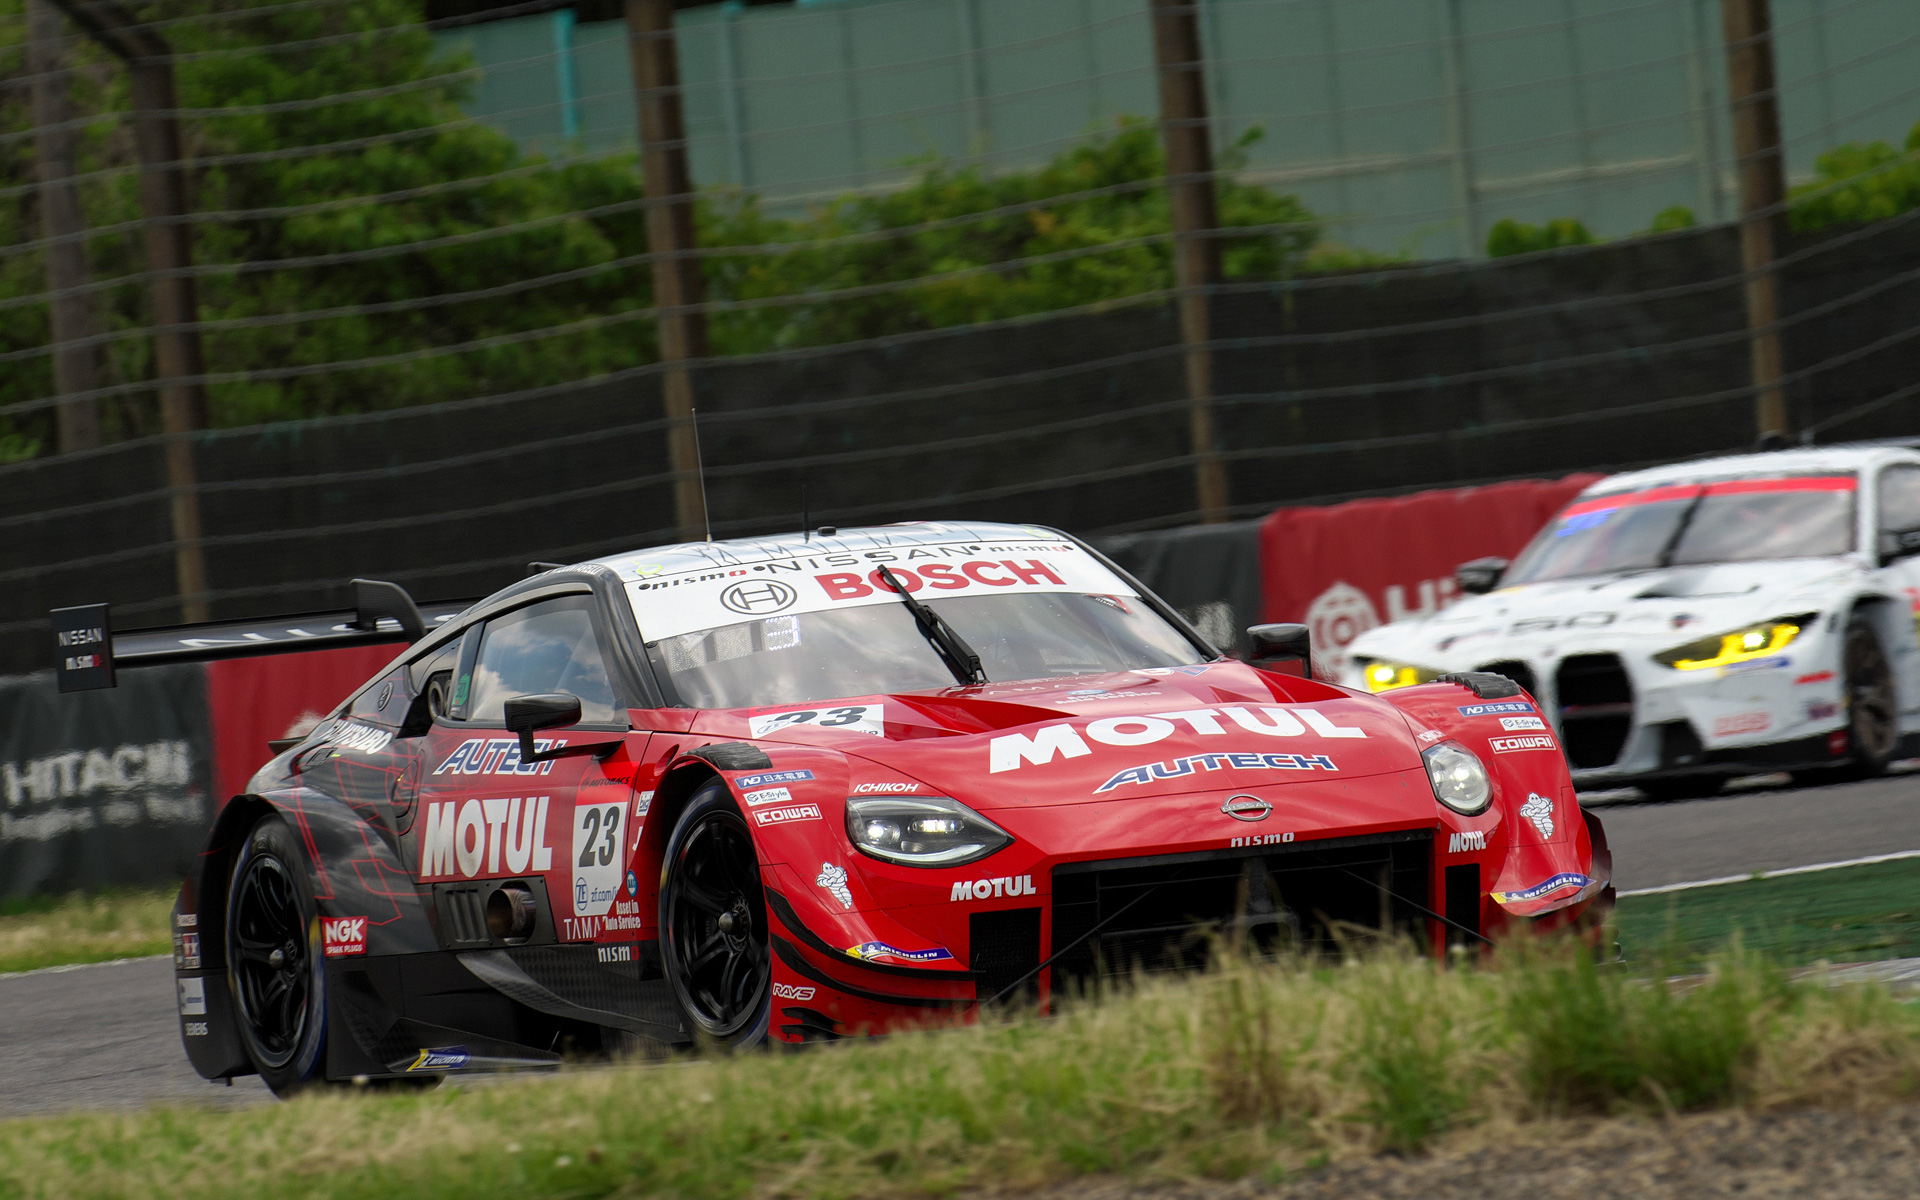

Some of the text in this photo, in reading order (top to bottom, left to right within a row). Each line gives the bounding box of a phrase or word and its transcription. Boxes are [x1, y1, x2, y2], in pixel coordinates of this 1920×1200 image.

[988, 544, 1068, 553] nismo
[766, 545, 971, 573] NISSAN
[652, 571, 746, 590] nismo
[814, 560, 1066, 601] BOSCH
[58, 628, 103, 646] NISSAN
[989, 706, 1369, 774] MOTUL
[1492, 737, 1552, 751] KOIWAI
[433, 738, 567, 776] AUTECH
[2, 741, 190, 808] HITACHI
[589, 777, 631, 787] AUTOBACS
[1092, 752, 1340, 794] AUTECH
[759, 790, 788, 798] E-Style
[854, 783, 919, 793] ICHIKOH
[757, 806, 819, 823] KOIWAI
[1223, 802, 1272, 812] NISSAN
[421, 796, 553, 878] MOTUL
[578, 806, 621, 868] 23
[1231, 832, 1295, 848] nismo
[1448, 830, 1487, 853] MOTUL
[950, 875, 1036, 901] MOTUL
[1524, 876, 1582, 898] MICHELIN
[325, 919, 364, 944] NGK
[606, 914, 641, 931] Auto Service
[598, 945, 640, 962] nismo
[880, 944, 938, 959] MICHELIN
[773, 982, 816, 1001] RAYS
